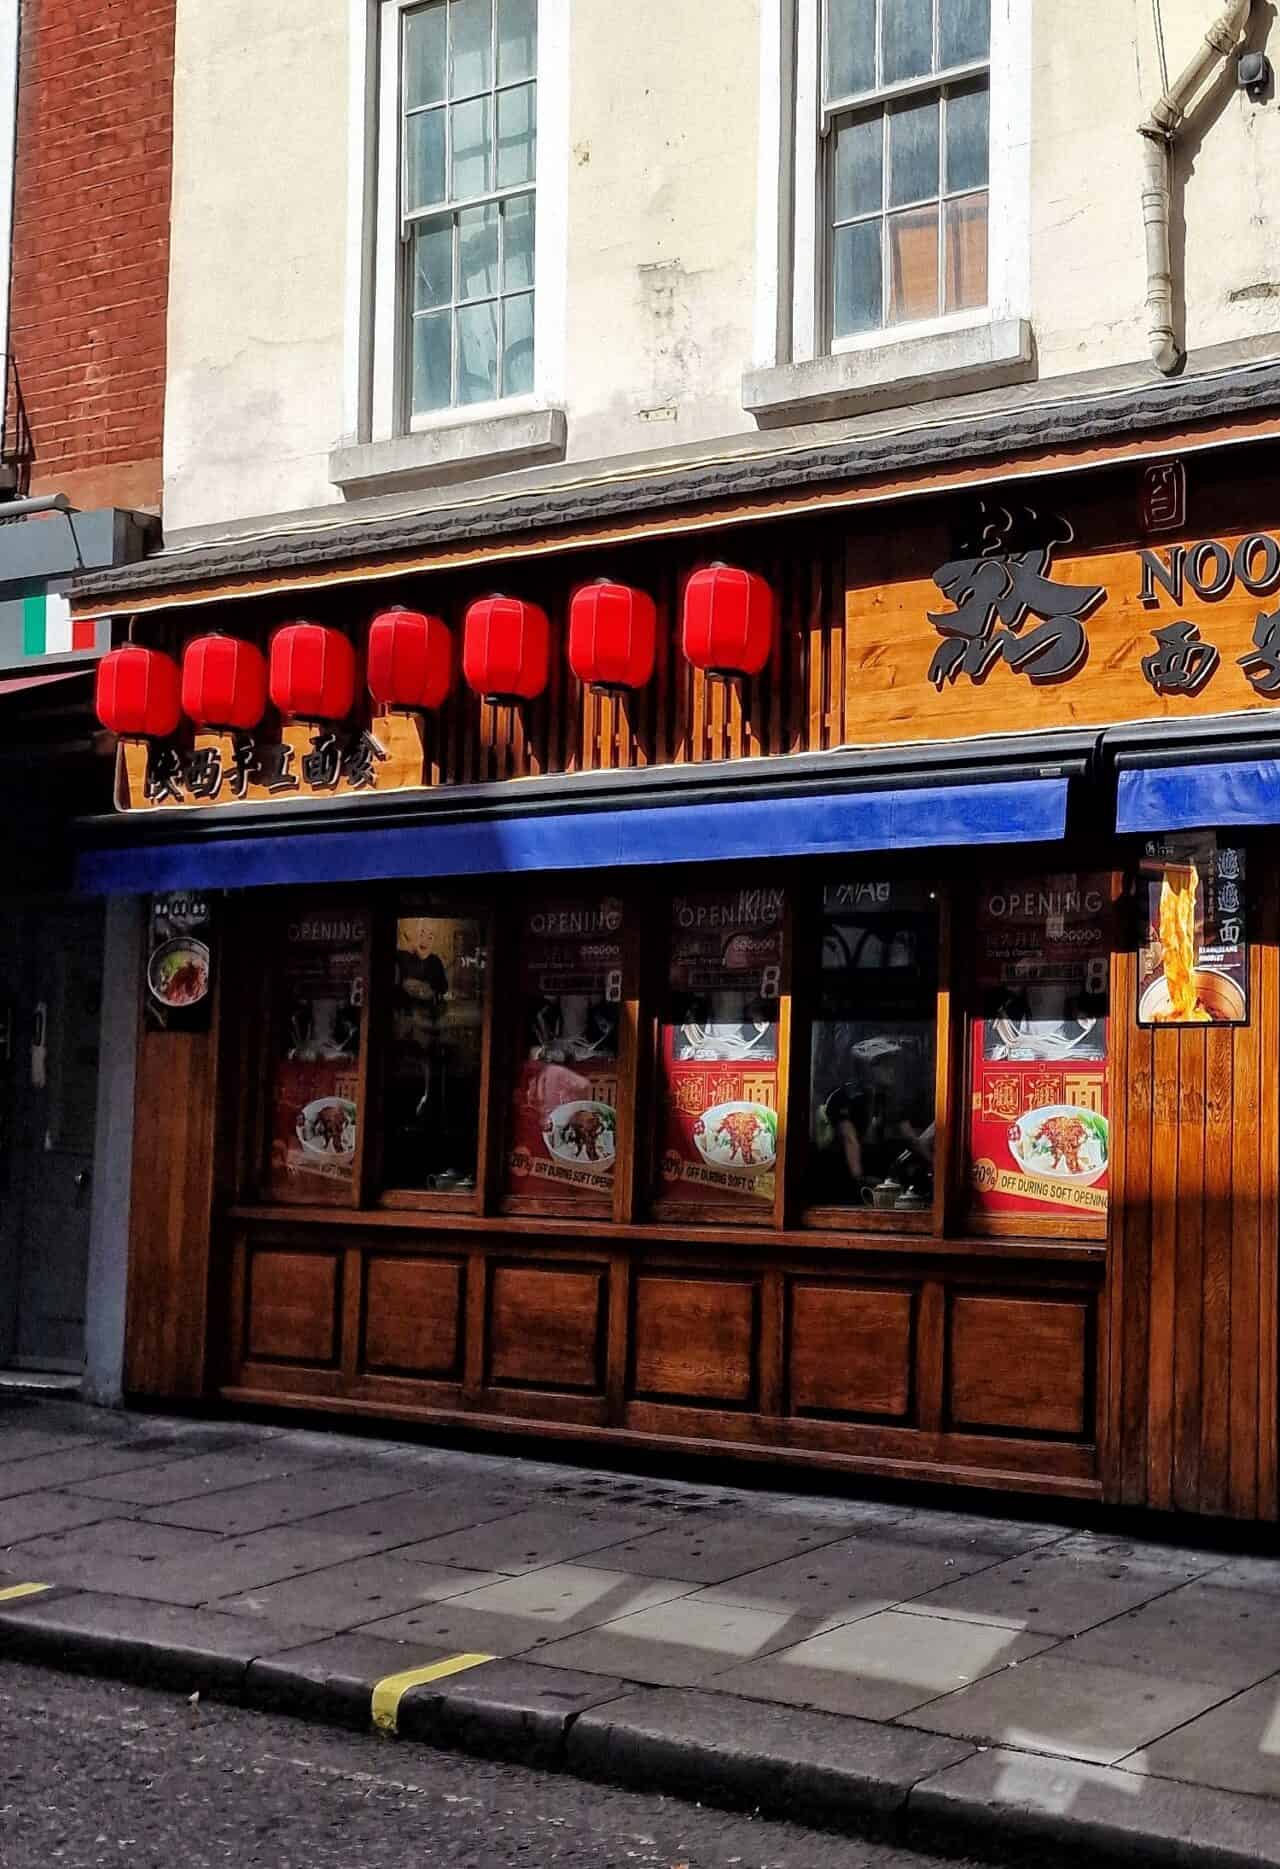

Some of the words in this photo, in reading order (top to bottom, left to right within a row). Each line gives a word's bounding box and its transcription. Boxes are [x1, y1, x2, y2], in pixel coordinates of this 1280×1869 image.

[989, 891, 1104, 917] OPENING
[1001, 1175, 1017, 1189] OFF
[1018, 1179, 1048, 1198] DURING
[1050, 1184, 1072, 1201] SOFT
